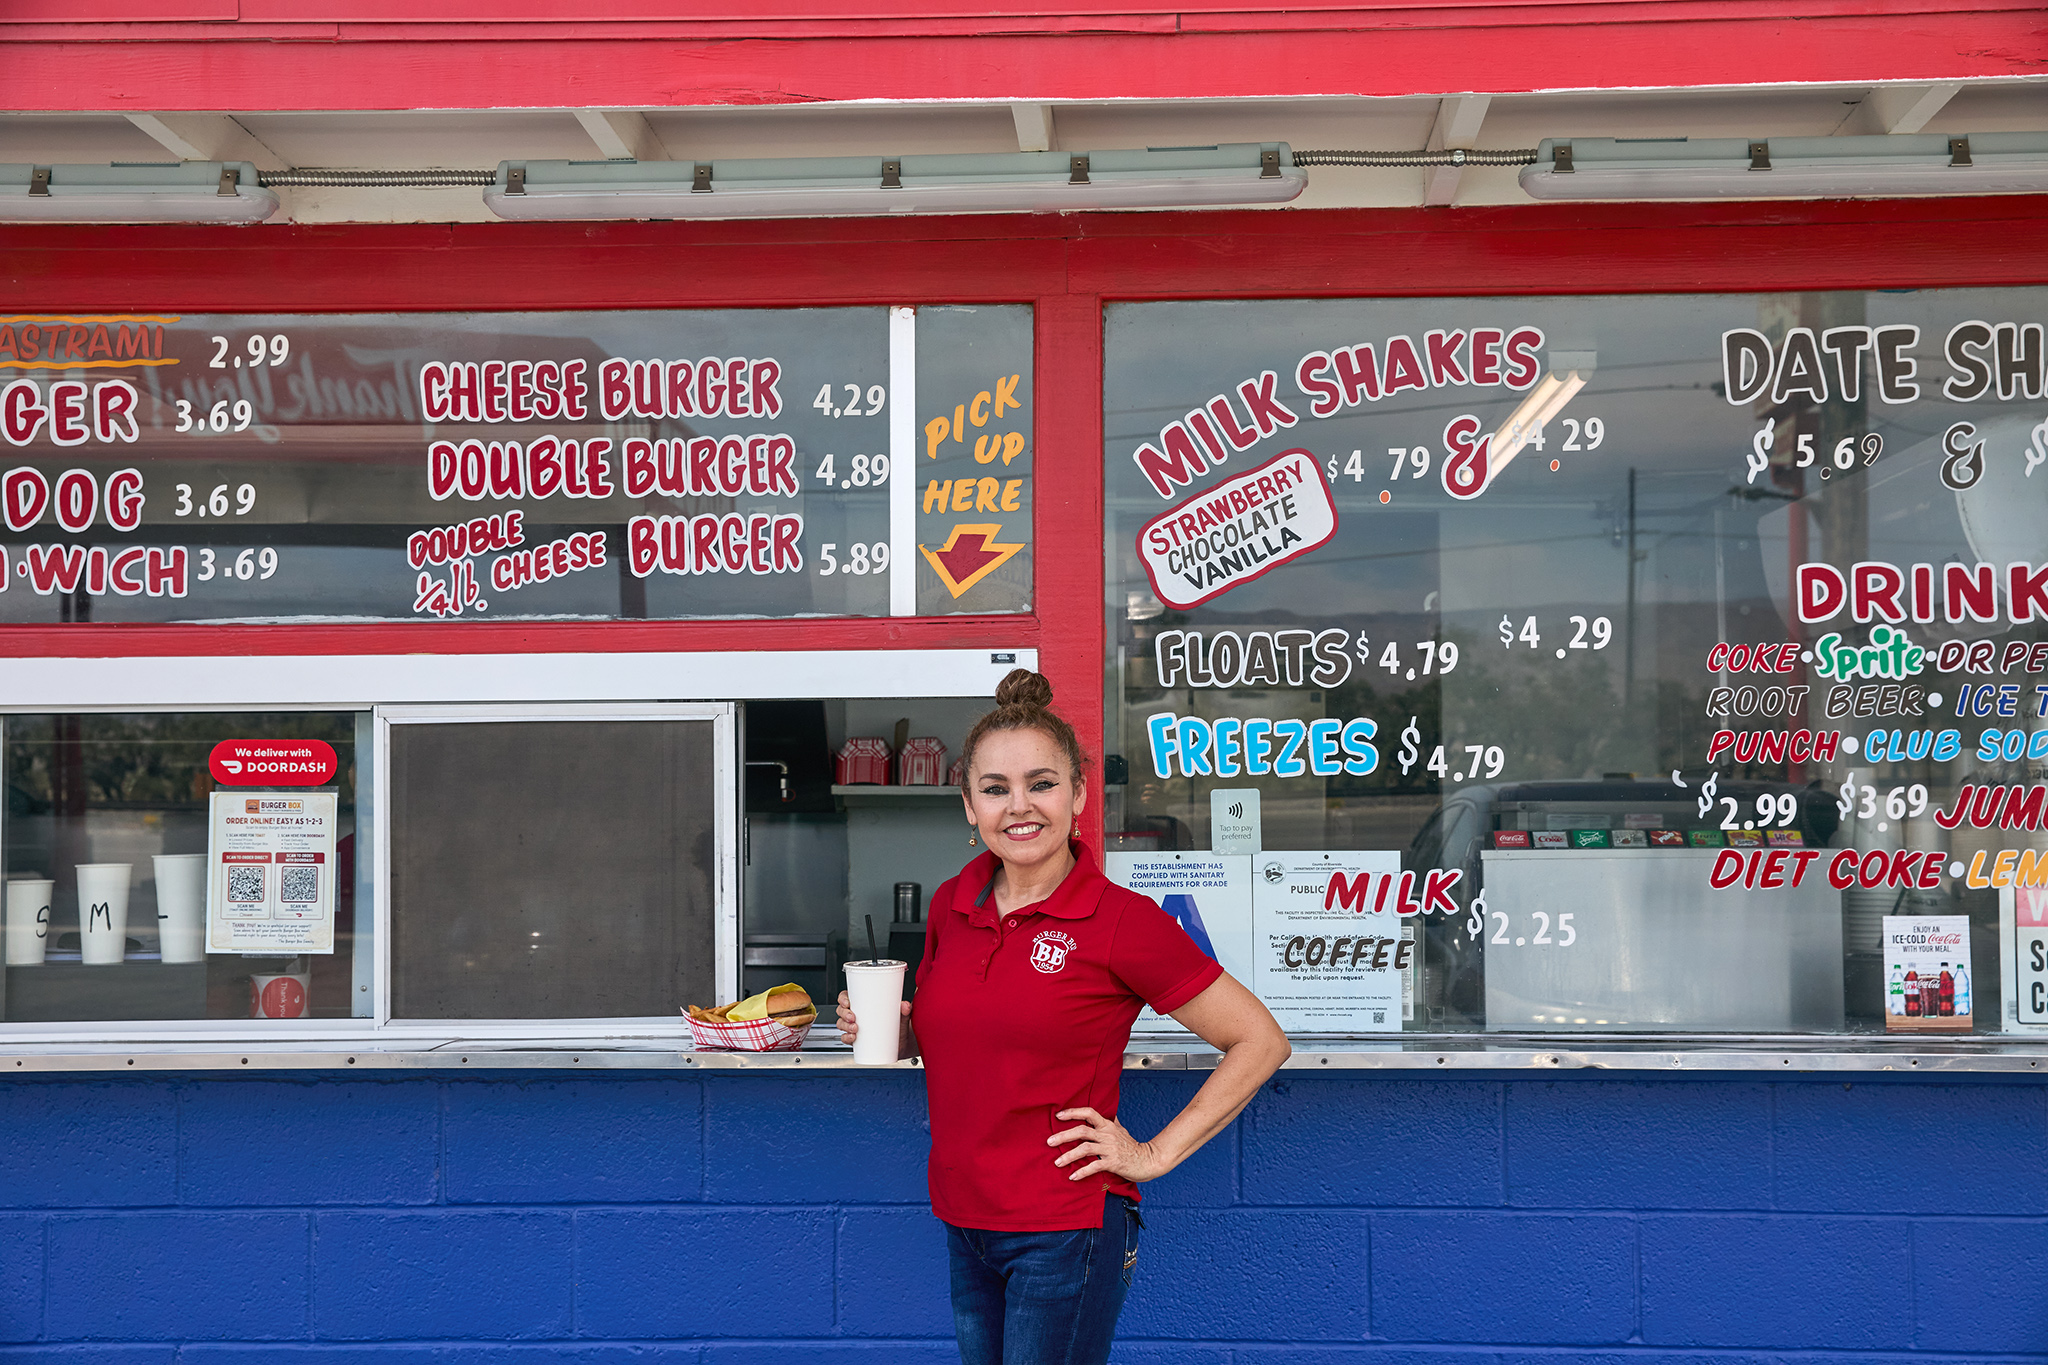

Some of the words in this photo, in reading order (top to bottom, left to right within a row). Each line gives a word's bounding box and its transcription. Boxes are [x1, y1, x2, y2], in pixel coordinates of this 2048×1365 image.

[209, 334, 290, 369] 2.99
[1721, 324, 1921, 406] DATE
[1942, 319, 2048, 402] SH
[420, 358, 589, 423] CHEESE
[598, 356, 784, 421] BURGER
[0, 378, 141, 447] GER
[174, 399, 253, 433] 3.69
[924, 373, 1022, 460] PICK
[1132, 369, 1300, 501] MILK
[1294, 325, 1546, 419] SHAKES
[428, 434, 615, 501] DOUBLE
[622, 432, 801, 499] BURGER
[815, 453, 891, 489] 4.89
[973, 431, 1026, 467] UP
[1440, 413, 1498, 501] &
[1939, 420, 1988, 492] &
[1, 466, 146, 533] DOG
[174, 483, 257, 518] 3.69
[922, 476, 1023, 515] HERE
[1147, 458, 1306, 556] STRAWBERRY
[406, 509, 526, 570] DOUBLE
[490, 530, 608, 593] CHEESE
[627, 511, 804, 578] BURGER
[819, 541, 891, 577] 5.89
[1166, 492, 1298, 576] CHOCOLATE
[197, 547, 279, 582] 3.69
[1182, 526, 1303, 591] VANILLA
[1796, 561, 2048, 623] DRINK
[1154, 628, 1354, 689] FLOATS
[1706, 641, 1800, 674] COKE
[1814, 623, 1925, 682] Sprite
[1935, 639, 1995, 675] DR
[1999, 641, 2048, 674] PE
[1705, 685, 1810, 718] ROOT
[1824, 684, 1926, 719] BEER
[1954, 683, 2021, 717] ICE
[234, 747, 252, 757] We
[253, 747, 289, 758] deliver
[289, 747, 312, 757] with
[1146, 711, 1380, 780] FREEZES
[1706, 729, 1841, 764] PUNCH
[1863, 728, 1961, 763] CLUB
[247, 761, 327, 773] DOORDASH
[225, 817, 249, 825] ORDER
[249, 817, 276, 825] ONLINE!
[276, 817, 294, 825] EASY
[294, 817, 305, 825] AS
[305, 817, 323, 825] 1-2-3
[260, 801, 287, 809] BURGER
[288, 801, 302, 809] BOX
[1933, 784, 2048, 833] JUM
[1220, 824, 1232, 832] Tap
[1221, 833, 1252, 841] preferred
[1129, 880, 1184, 889] REQUIREMENTS
[1184, 880, 1201, 888] FOR
[1202, 880, 1228, 888] GRADE
[1131, 871, 1169, 879] COMPLIED
[1169, 871, 1188, 879] WITH
[1188, 871, 1226, 879] SANITARY
[1132, 863, 1149, 871] THIS
[1149, 862, 1207, 871] ESTABLISHMENT
[1207, 862, 1224, 870] HAS
[1708, 848, 1820, 890] DIET
[1827, 848, 1948, 890] COKE
[1965, 849, 2048, 889] LEM
[1290, 885, 1325, 895] PUBLIC
[1323, 867, 1463, 918] MILK
[36, 904, 50, 939] S
[89, 901, 111, 933] M
[1913, 925, 1930, 933] ENJOY
[1931, 925, 1941, 933] AN
[1032, 930, 1067, 943] BURGER
[1067, 937, 1077, 951] BO
[1032, 941, 1066, 966] BB
[1283, 934, 1416, 973] COFFEE
[1892, 934, 1927, 945] ICE-COLD
[1902, 944, 1918, 953] WITH
[1919, 944, 1934, 953] YOUR
[1322, 966, 1344, 974] facility
